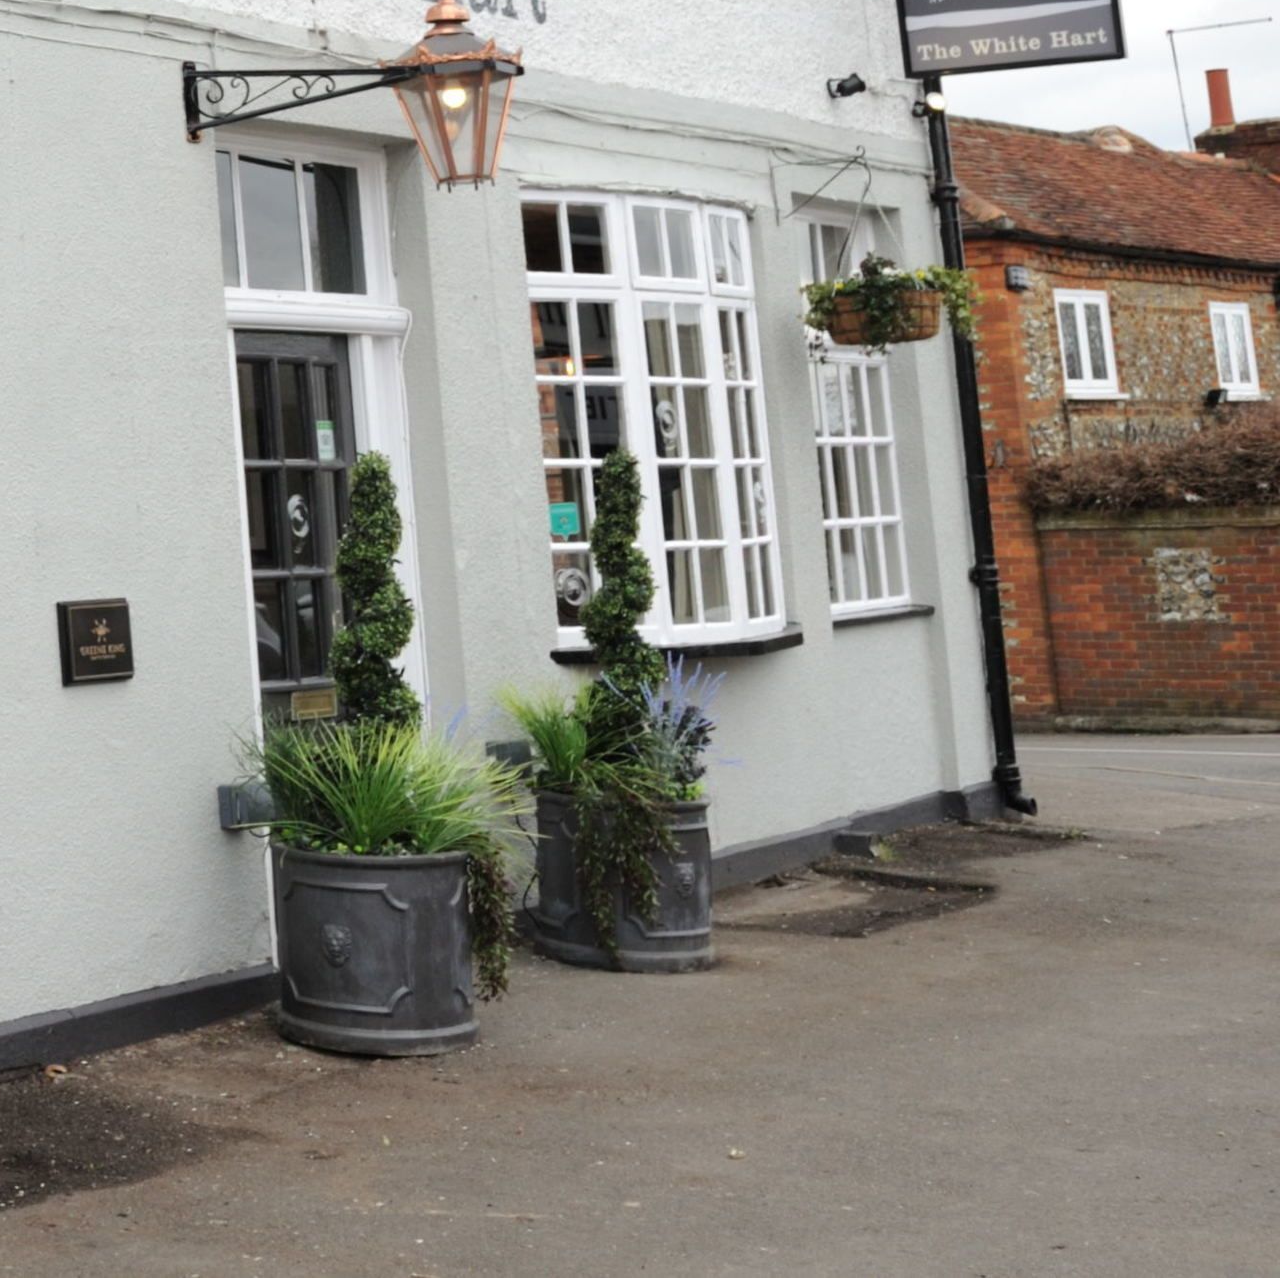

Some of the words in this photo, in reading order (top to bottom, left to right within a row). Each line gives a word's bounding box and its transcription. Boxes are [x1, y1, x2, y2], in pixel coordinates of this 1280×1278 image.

[916, 43, 962, 62] The
[969, 36, 1041, 57] White
[1050, 27, 1109, 49] Hart
